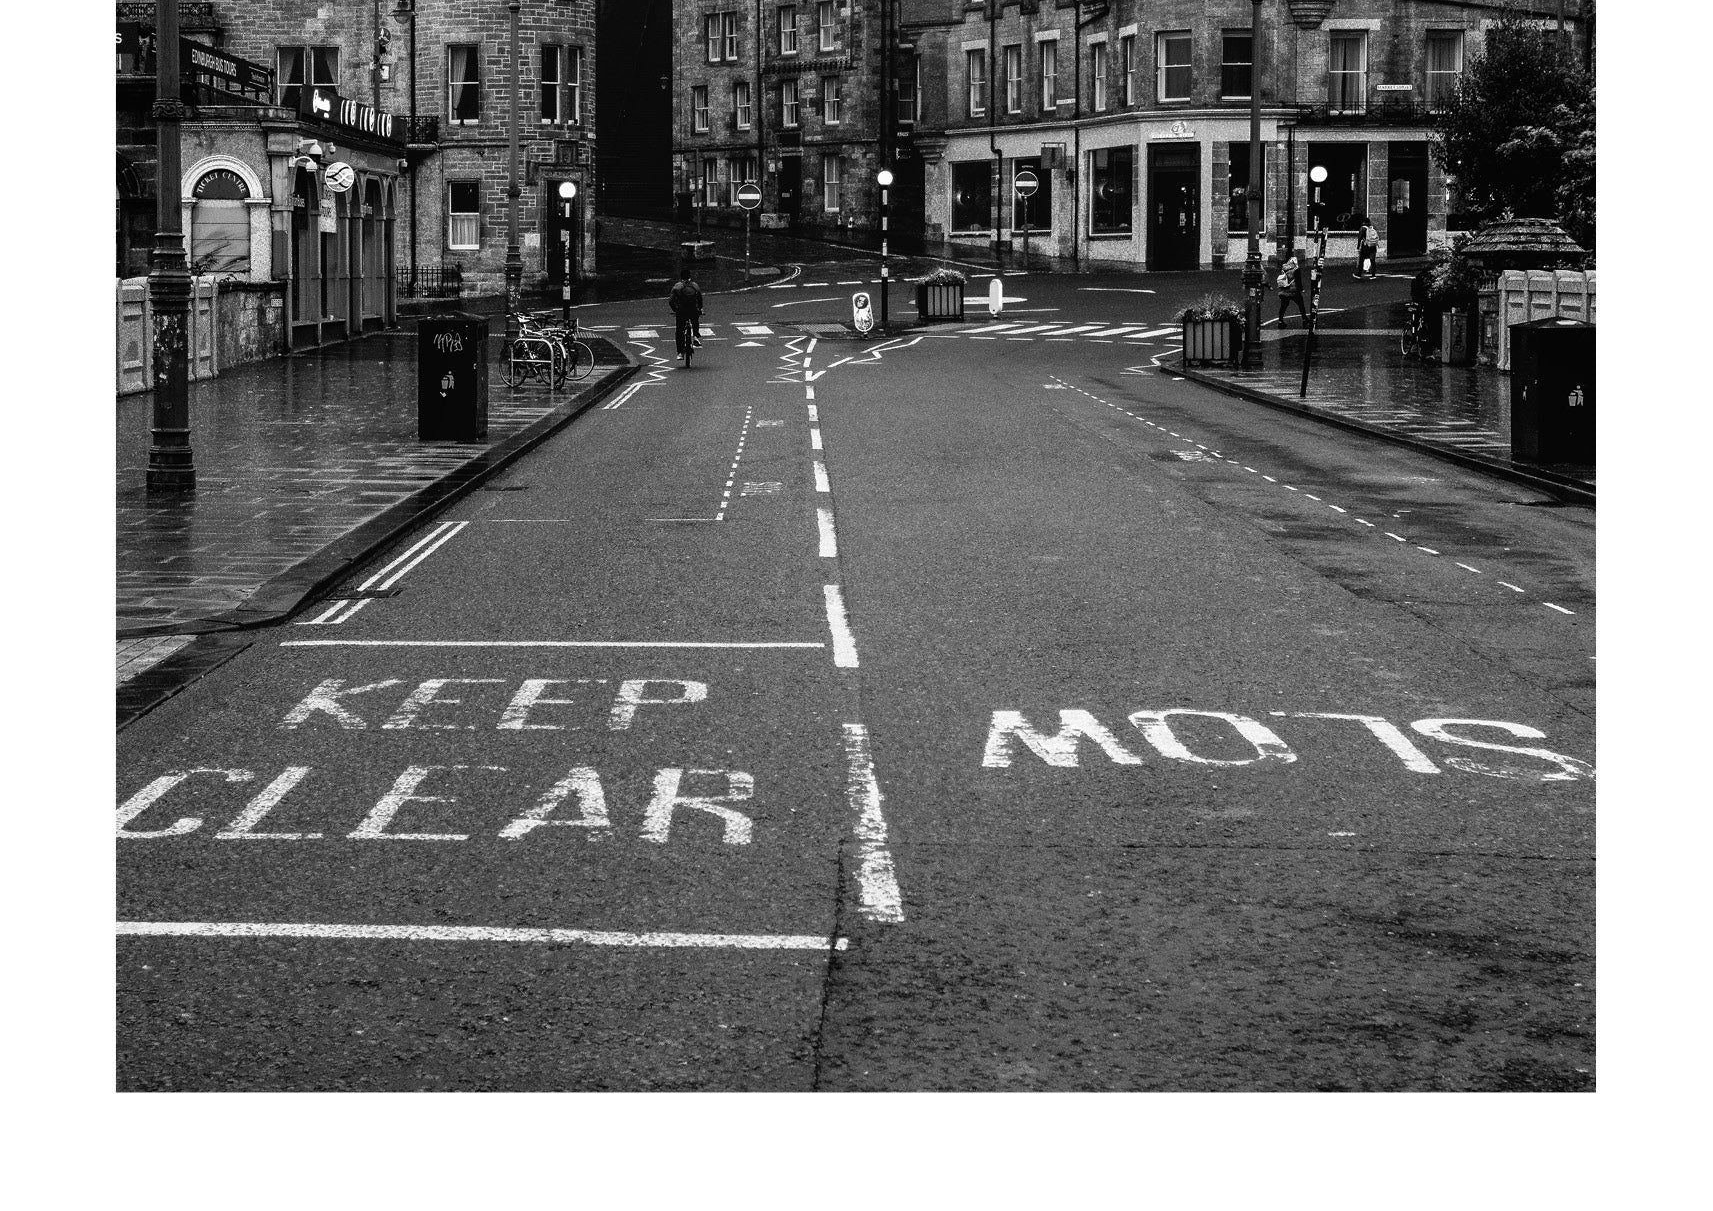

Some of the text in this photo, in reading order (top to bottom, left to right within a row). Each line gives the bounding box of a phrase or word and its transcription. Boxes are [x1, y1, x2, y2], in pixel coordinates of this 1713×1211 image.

[191, 48, 237, 77] EDINBURGH BUS TOURS
[196, 171, 246, 193] TICKET CENTRE
[277, 678, 708, 730] KEEP
[981, 708, 1596, 781] SLOW
[116, 764, 756, 846] CLEAR
